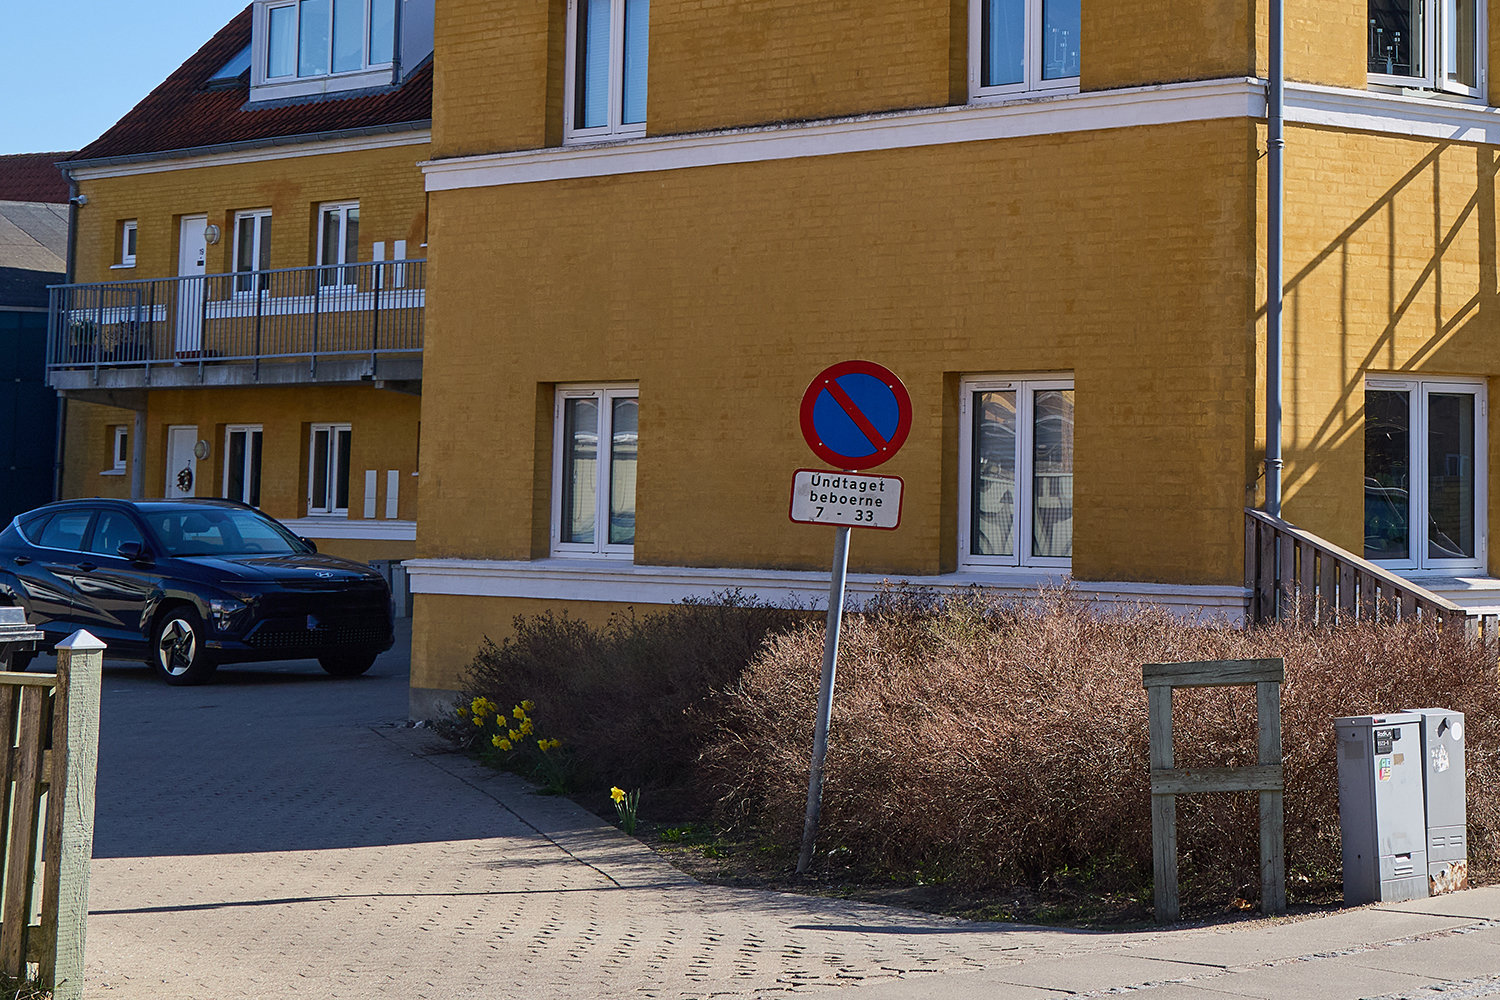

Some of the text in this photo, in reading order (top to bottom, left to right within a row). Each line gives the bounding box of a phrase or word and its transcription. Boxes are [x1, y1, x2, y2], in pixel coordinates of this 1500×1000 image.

[811, 474, 885, 492] Undtaget
[810, 490, 882, 507] beboerne
[816, 506, 824, 518] 7
[855, 509, 874, 522] 33
